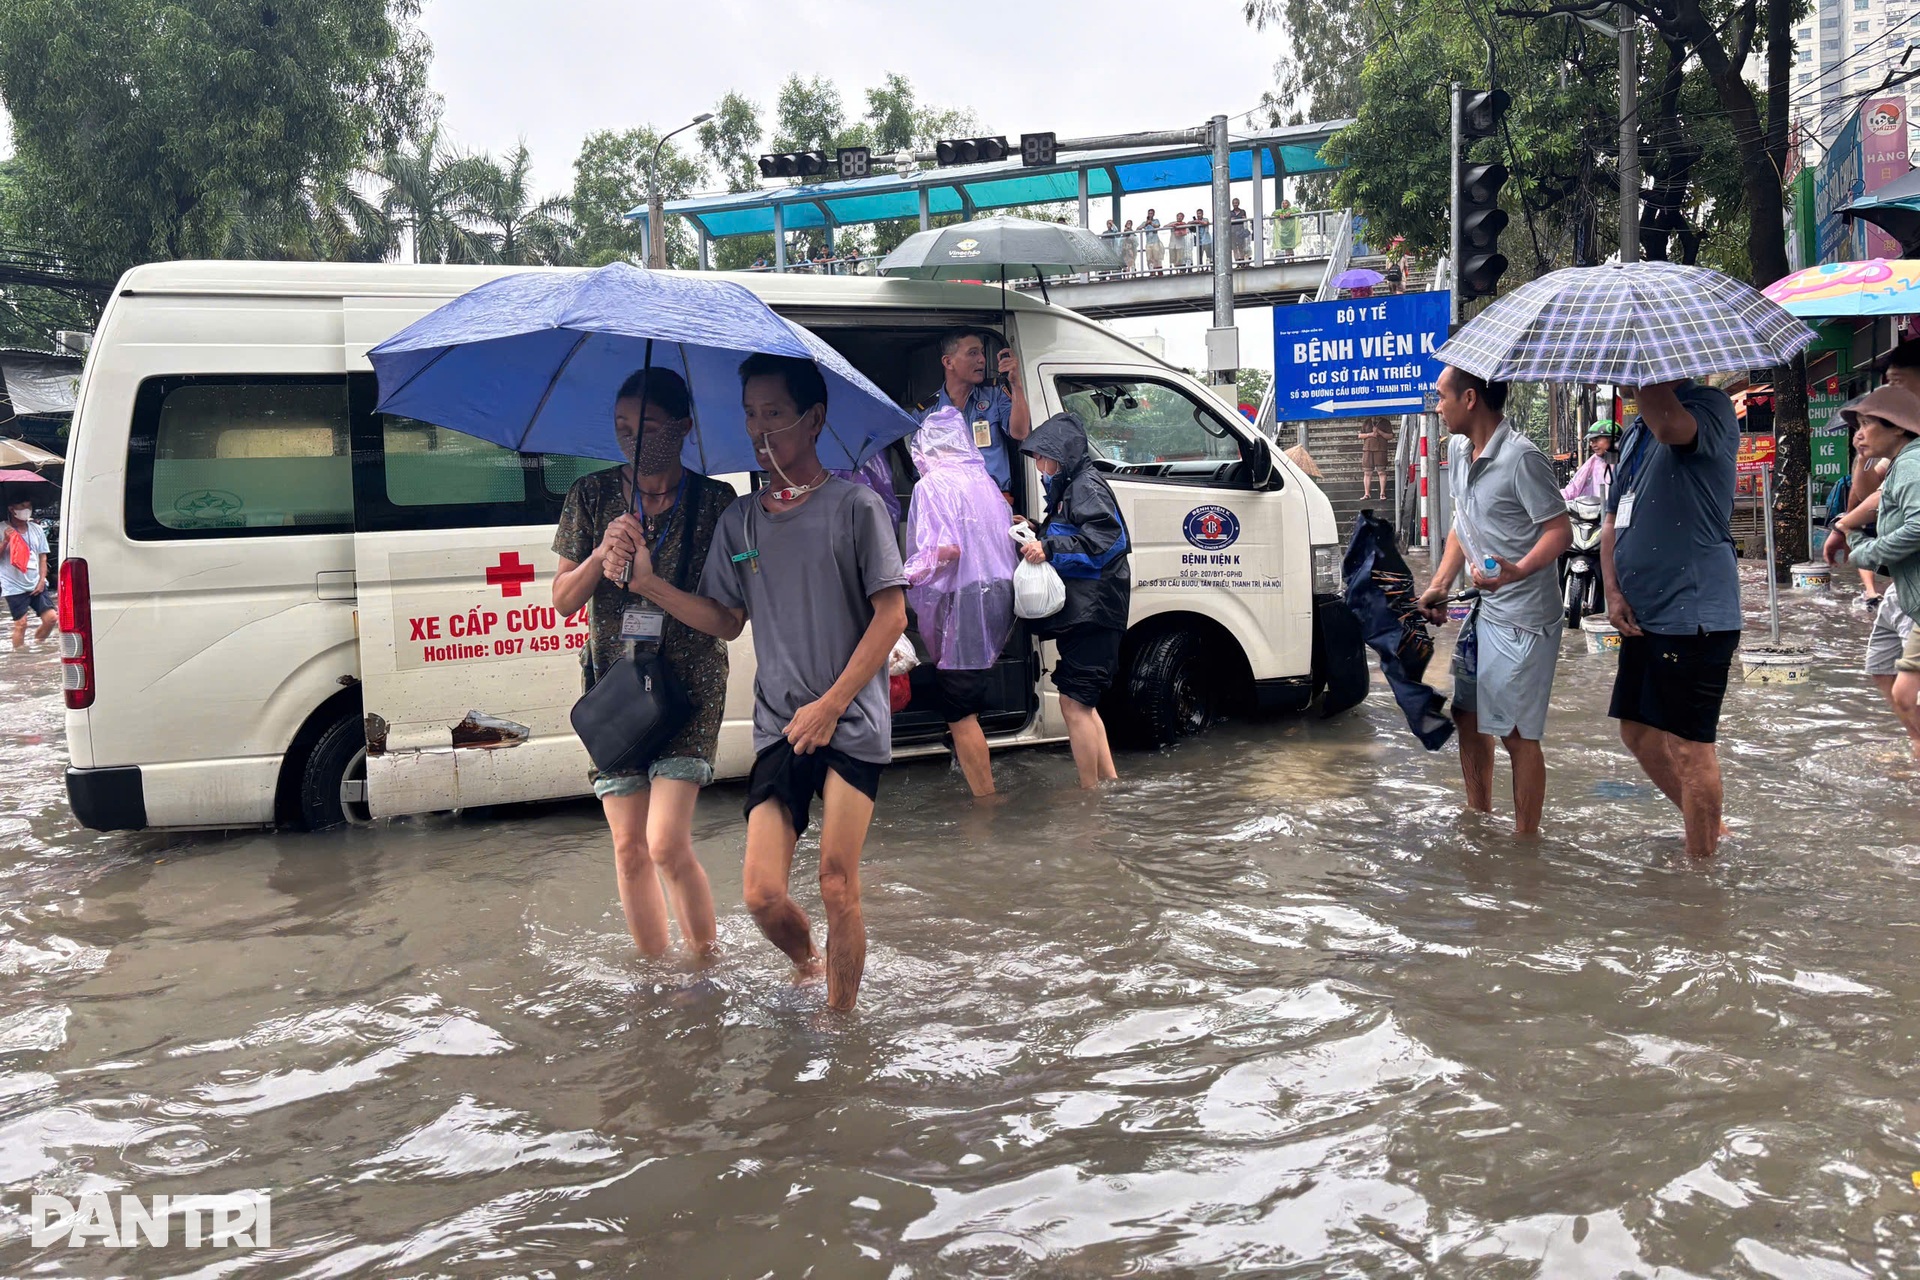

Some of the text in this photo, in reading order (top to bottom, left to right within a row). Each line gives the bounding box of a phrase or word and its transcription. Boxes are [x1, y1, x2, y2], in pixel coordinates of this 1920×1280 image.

[1867, 151, 1906, 163] HÀNG
[1337, 301, 1387, 326] BỘ Y TẾ
[1294, 331, 1436, 366] BỆNH VIỆN K
[1309, 370, 1327, 384] CƠ
[1331, 367, 1349, 383] SỞ
[1352, 366, 1379, 381] TÂN
[1290, 388, 1300, 399] SỐ
[1300, 390, 1310, 398] 30
[1376, 384, 1399, 393] THANH
[1820, 442, 1835, 456] KÊ
[1815, 463, 1840, 475] ĐƠN
[1182, 552, 1240, 566] BỆNH VIỆN K
[1180, 569, 1189, 577] SỐ
[1149, 578, 1158, 587] SỐ
[1231, 580, 1250, 588] THANH
[1271, 579, 1282, 589] NỘI
[409, 616, 441, 641] XE
[449, 605, 498, 637] CẤP
[507, 604, 556, 633] CỨU
[424, 632, 590, 662] Hotline: 097 459 38
